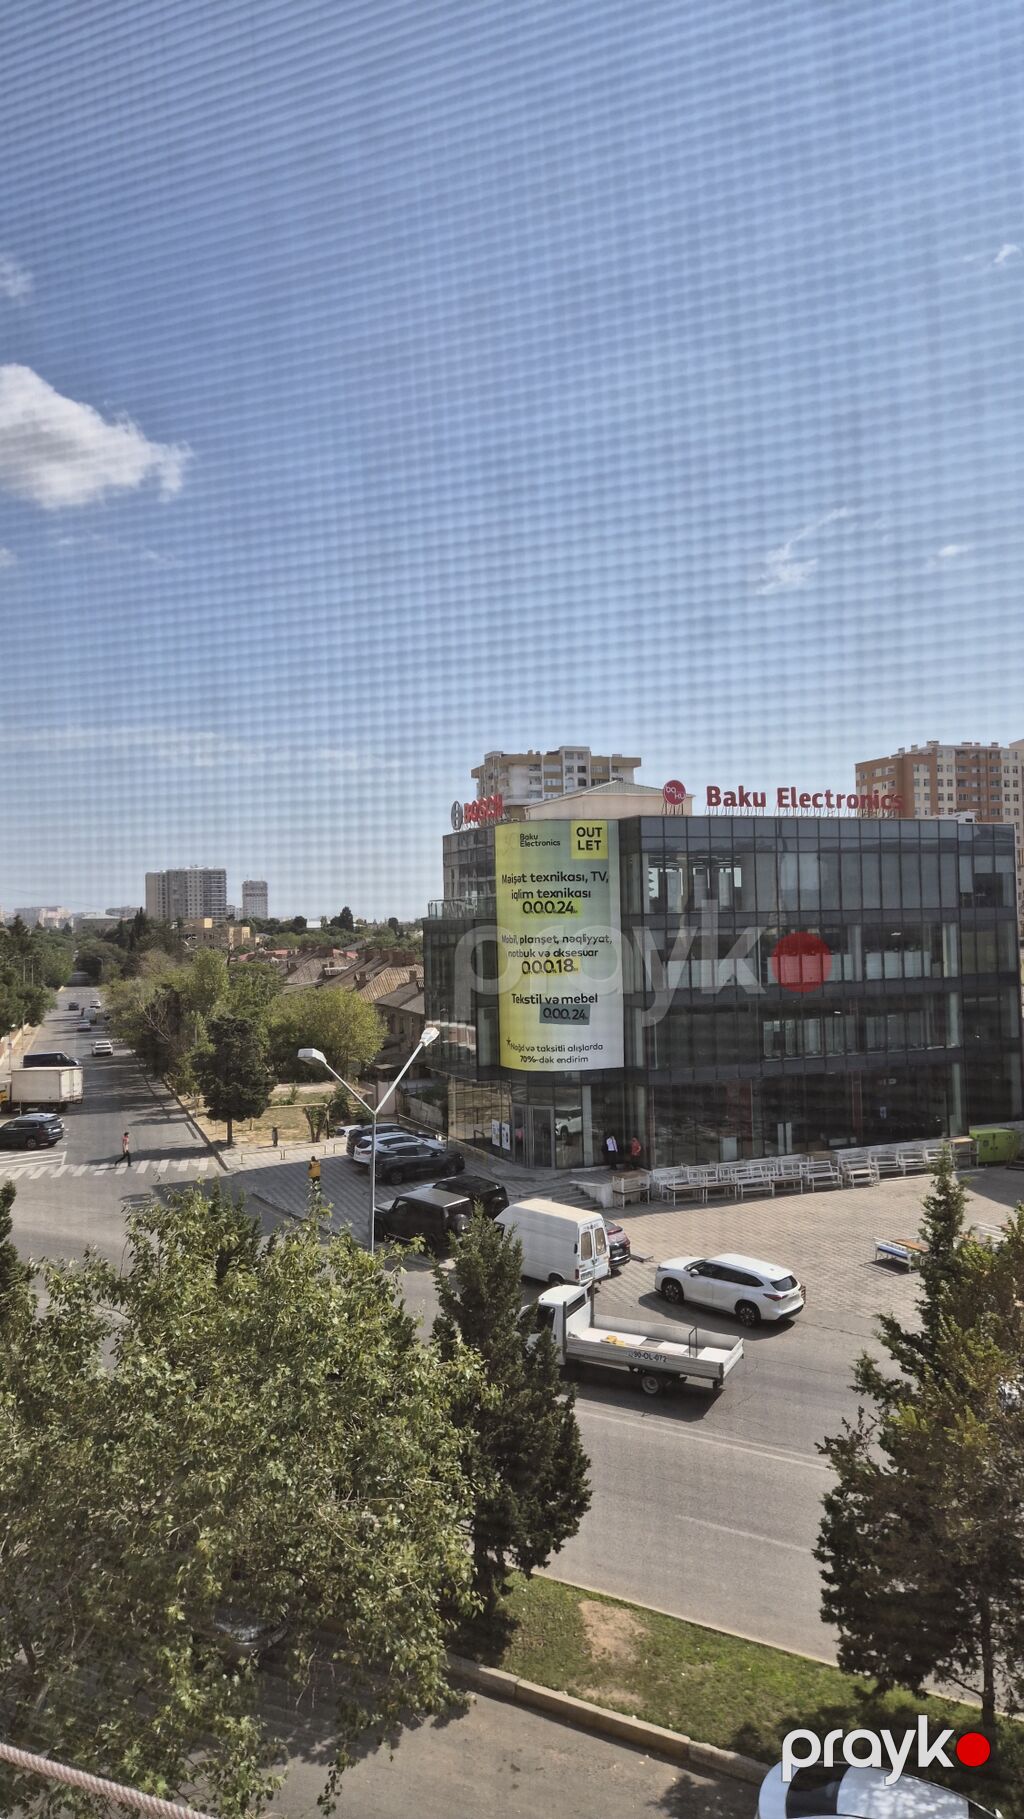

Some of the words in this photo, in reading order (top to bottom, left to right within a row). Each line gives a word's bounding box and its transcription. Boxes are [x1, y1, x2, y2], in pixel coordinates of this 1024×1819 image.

[706, 785, 767, 807] Baku
[777, 787, 904, 809] Electronics
[463, 793, 503, 824] BOSCH
[520, 833, 539, 841] Baku
[576, 827, 602, 838] OUT
[520, 839, 561, 848] Electronics
[577, 840, 602, 851] LET
[530, 871, 588, 883] texnikası,
[590, 871, 609, 883] TV,
[536, 888, 591, 899] texnikası
[519, 934, 560, 946] planşet,
[562, 933, 613, 945] nəqliyyat,
[538, 950, 551, 958] və
[511, 993, 542, 1005] Tekstil
[545, 996, 560, 1005] və
[561, 993, 599, 1004] mebel
[556, 1055, 589, 1064] endirim
